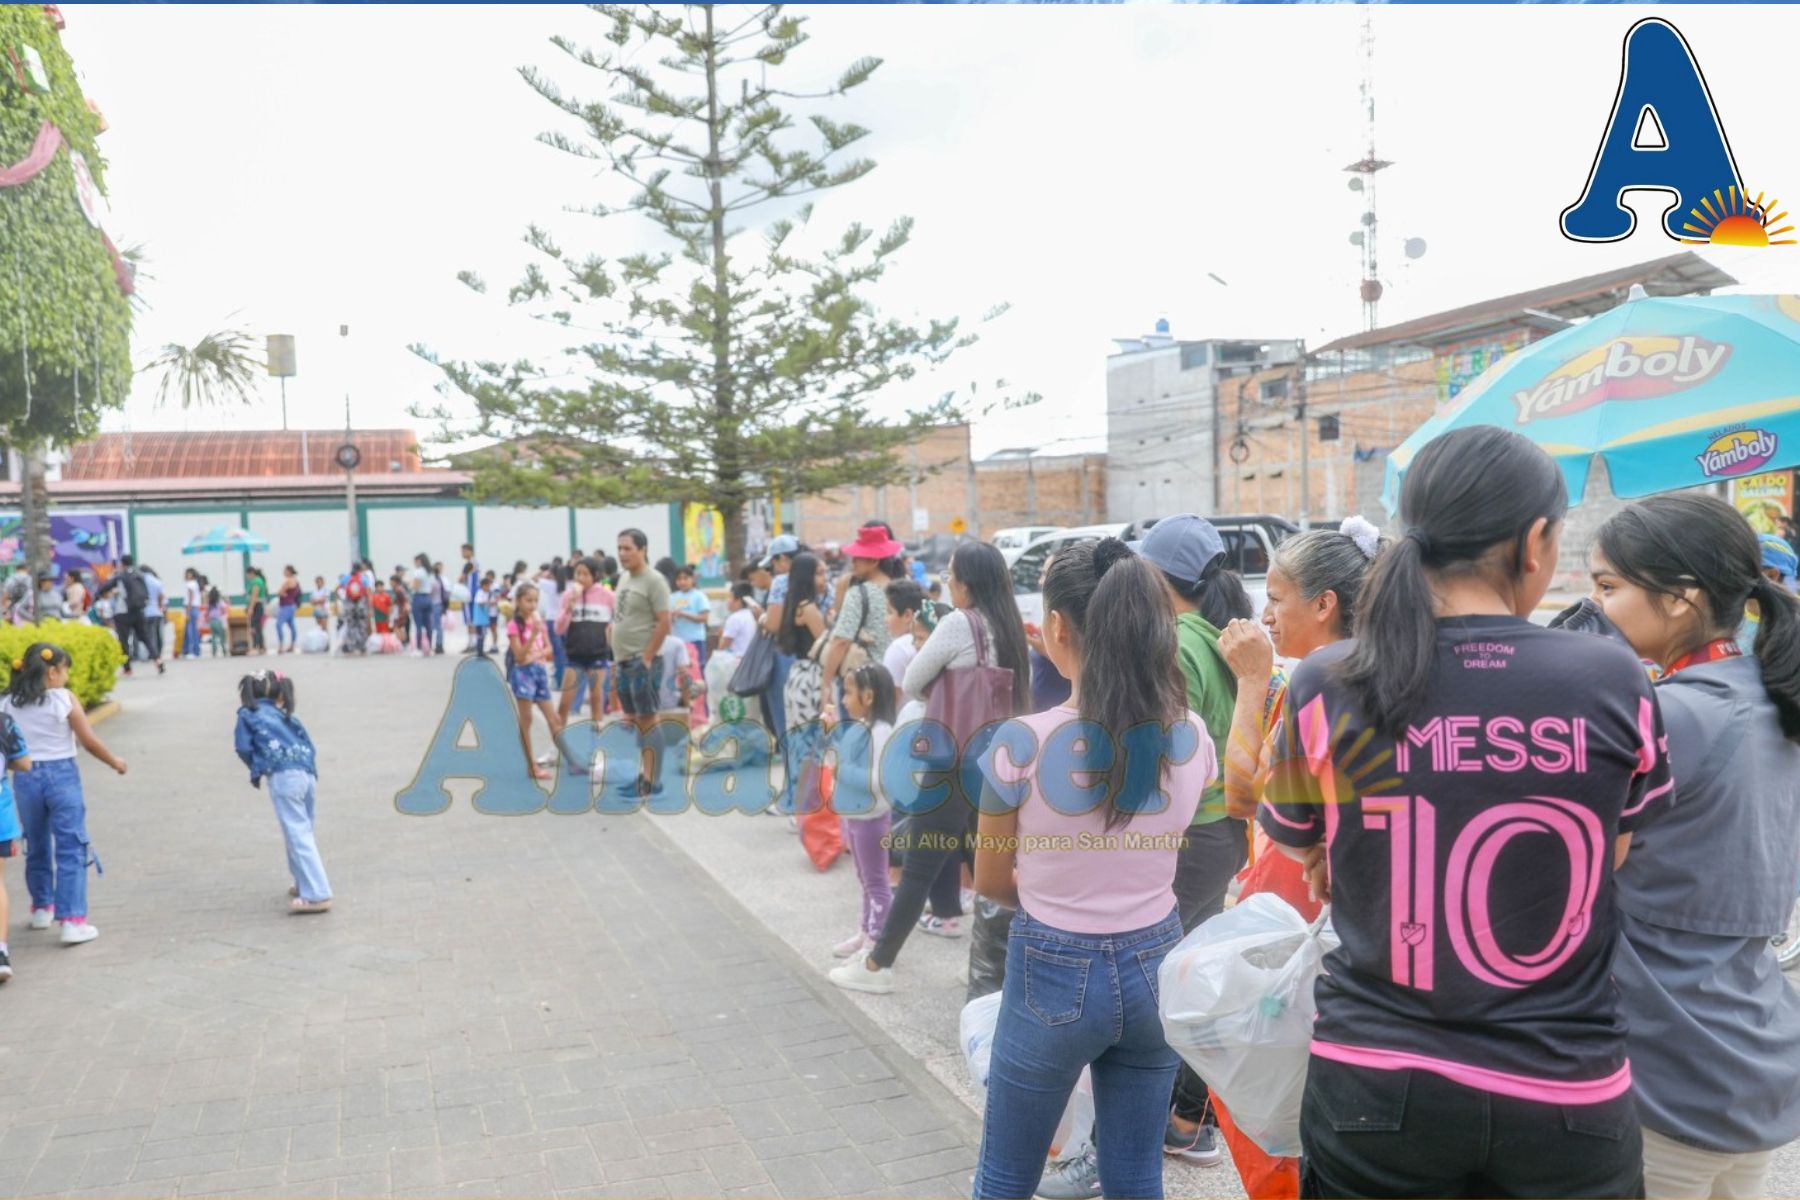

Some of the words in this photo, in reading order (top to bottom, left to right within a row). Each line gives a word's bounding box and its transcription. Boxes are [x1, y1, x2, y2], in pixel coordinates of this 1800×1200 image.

[1514, 335, 1726, 424] Yámboly
[1696, 429, 1775, 476] Yámboly
[1453, 642, 1515, 656] FREEDOM
[1463, 659, 1507, 669] DREAM
[1396, 715, 1587, 774] MESSI
[1361, 795, 1605, 991] 10
